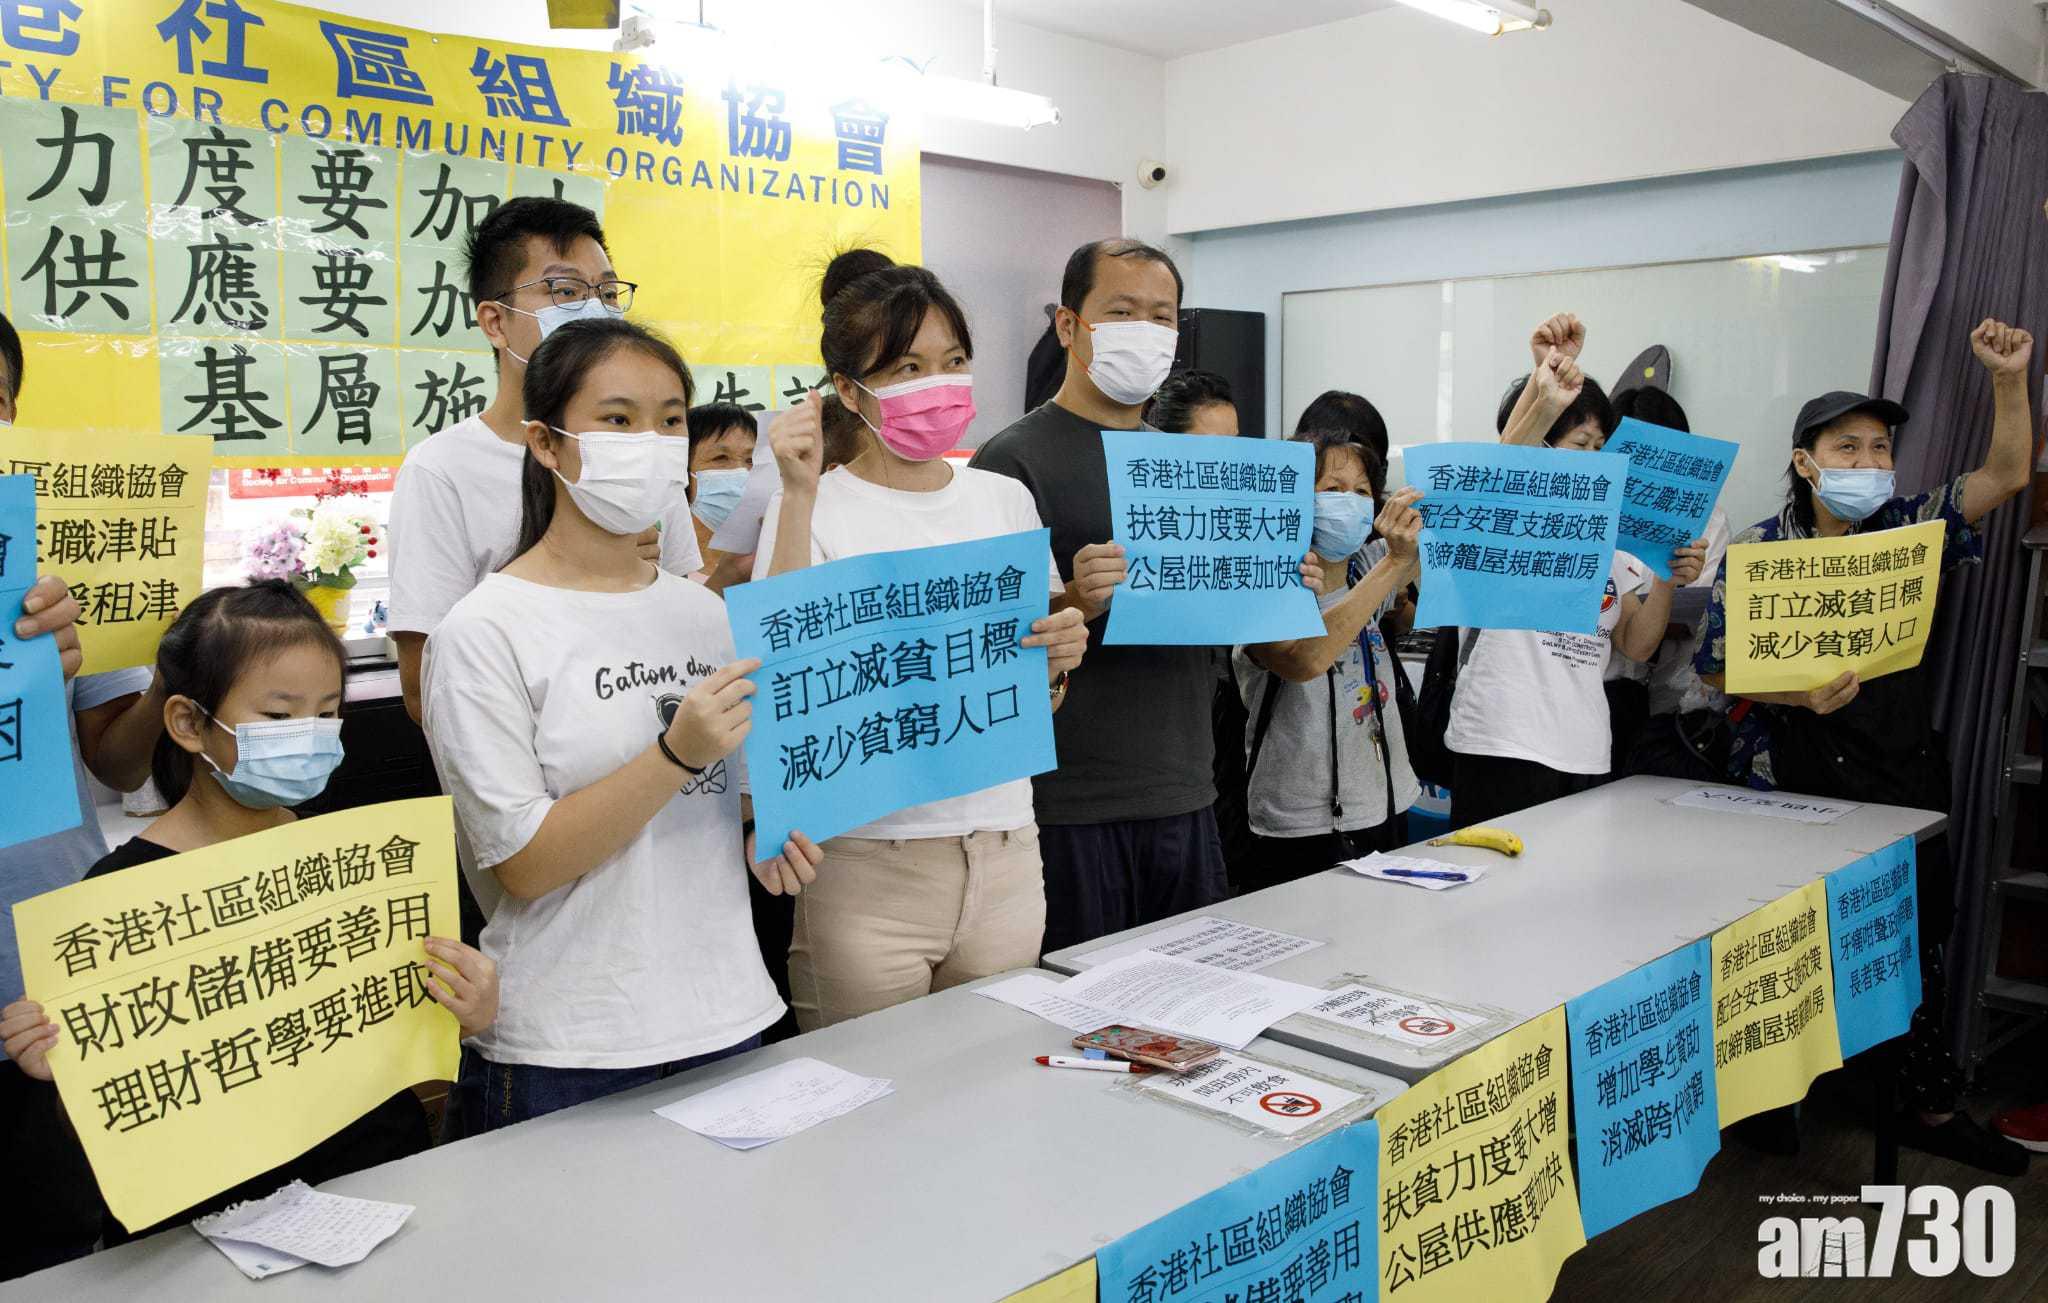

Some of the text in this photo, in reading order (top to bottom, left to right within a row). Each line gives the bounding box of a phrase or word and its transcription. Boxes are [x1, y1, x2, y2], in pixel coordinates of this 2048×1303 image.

[27, 105, 564, 241] 力度要加
[102, 75, 224, 125] FOR
[262, 99, 584, 171] COMMUNITY
[606, 146, 889, 211] ORGANIZATION
[0, 459, 189, 499] 區組織協會
[1126, 458, 1299, 496] 香港社區組織協會
[1427, 463, 1612, 502] 香港社區組織協會
[37, 516, 179, 565] 職津貼
[1126, 503, 1301, 544] 扶貧力度要大增
[1419, 503, 1609, 543] 配合安置支援政策
[1423, 541, 1600, 580] 取締籠屋規範劏房
[1744, 542, 1929, 583] 香港社區組織協會
[760, 564, 1026, 653] 香港社區組織協會
[1127, 553, 1300, 592] 公屋供應要加快
[1748, 576, 1925, 621] 訂立滅貧目標
[595, 661, 677, 700] Gation
[771, 617, 1019, 722] 訂立滅貧目標
[1748, 616, 1918, 661] 減少貧窮人口
[779, 684, 1020, 792] 減少貧窮人口
[54, 834, 421, 978] 香港社區組織協會
[1720, 905, 1817, 983] 香港社區組織協會
[60, 892, 432, 1062] 財政儲備要善用
[1584, 970, 1702, 1059] 香港社區組織協會
[91, 961, 440, 1133] 理財哲學要進取
[1596, 1018, 1701, 1109] 增加學生資助
[1386, 1043, 1553, 1167] 香港社區組織協會
[1601, 1070, 1705, 1167] 消滅跨代貧窮
[1382, 1091, 1558, 1234] 扶貧力度要大增
[1126, 1164, 1355, 1303] 香港社區組織協會
[1223, 1219, 1361, 1303] 要善用
[1384, 1150, 1565, 1294] 公屋供應要加快
